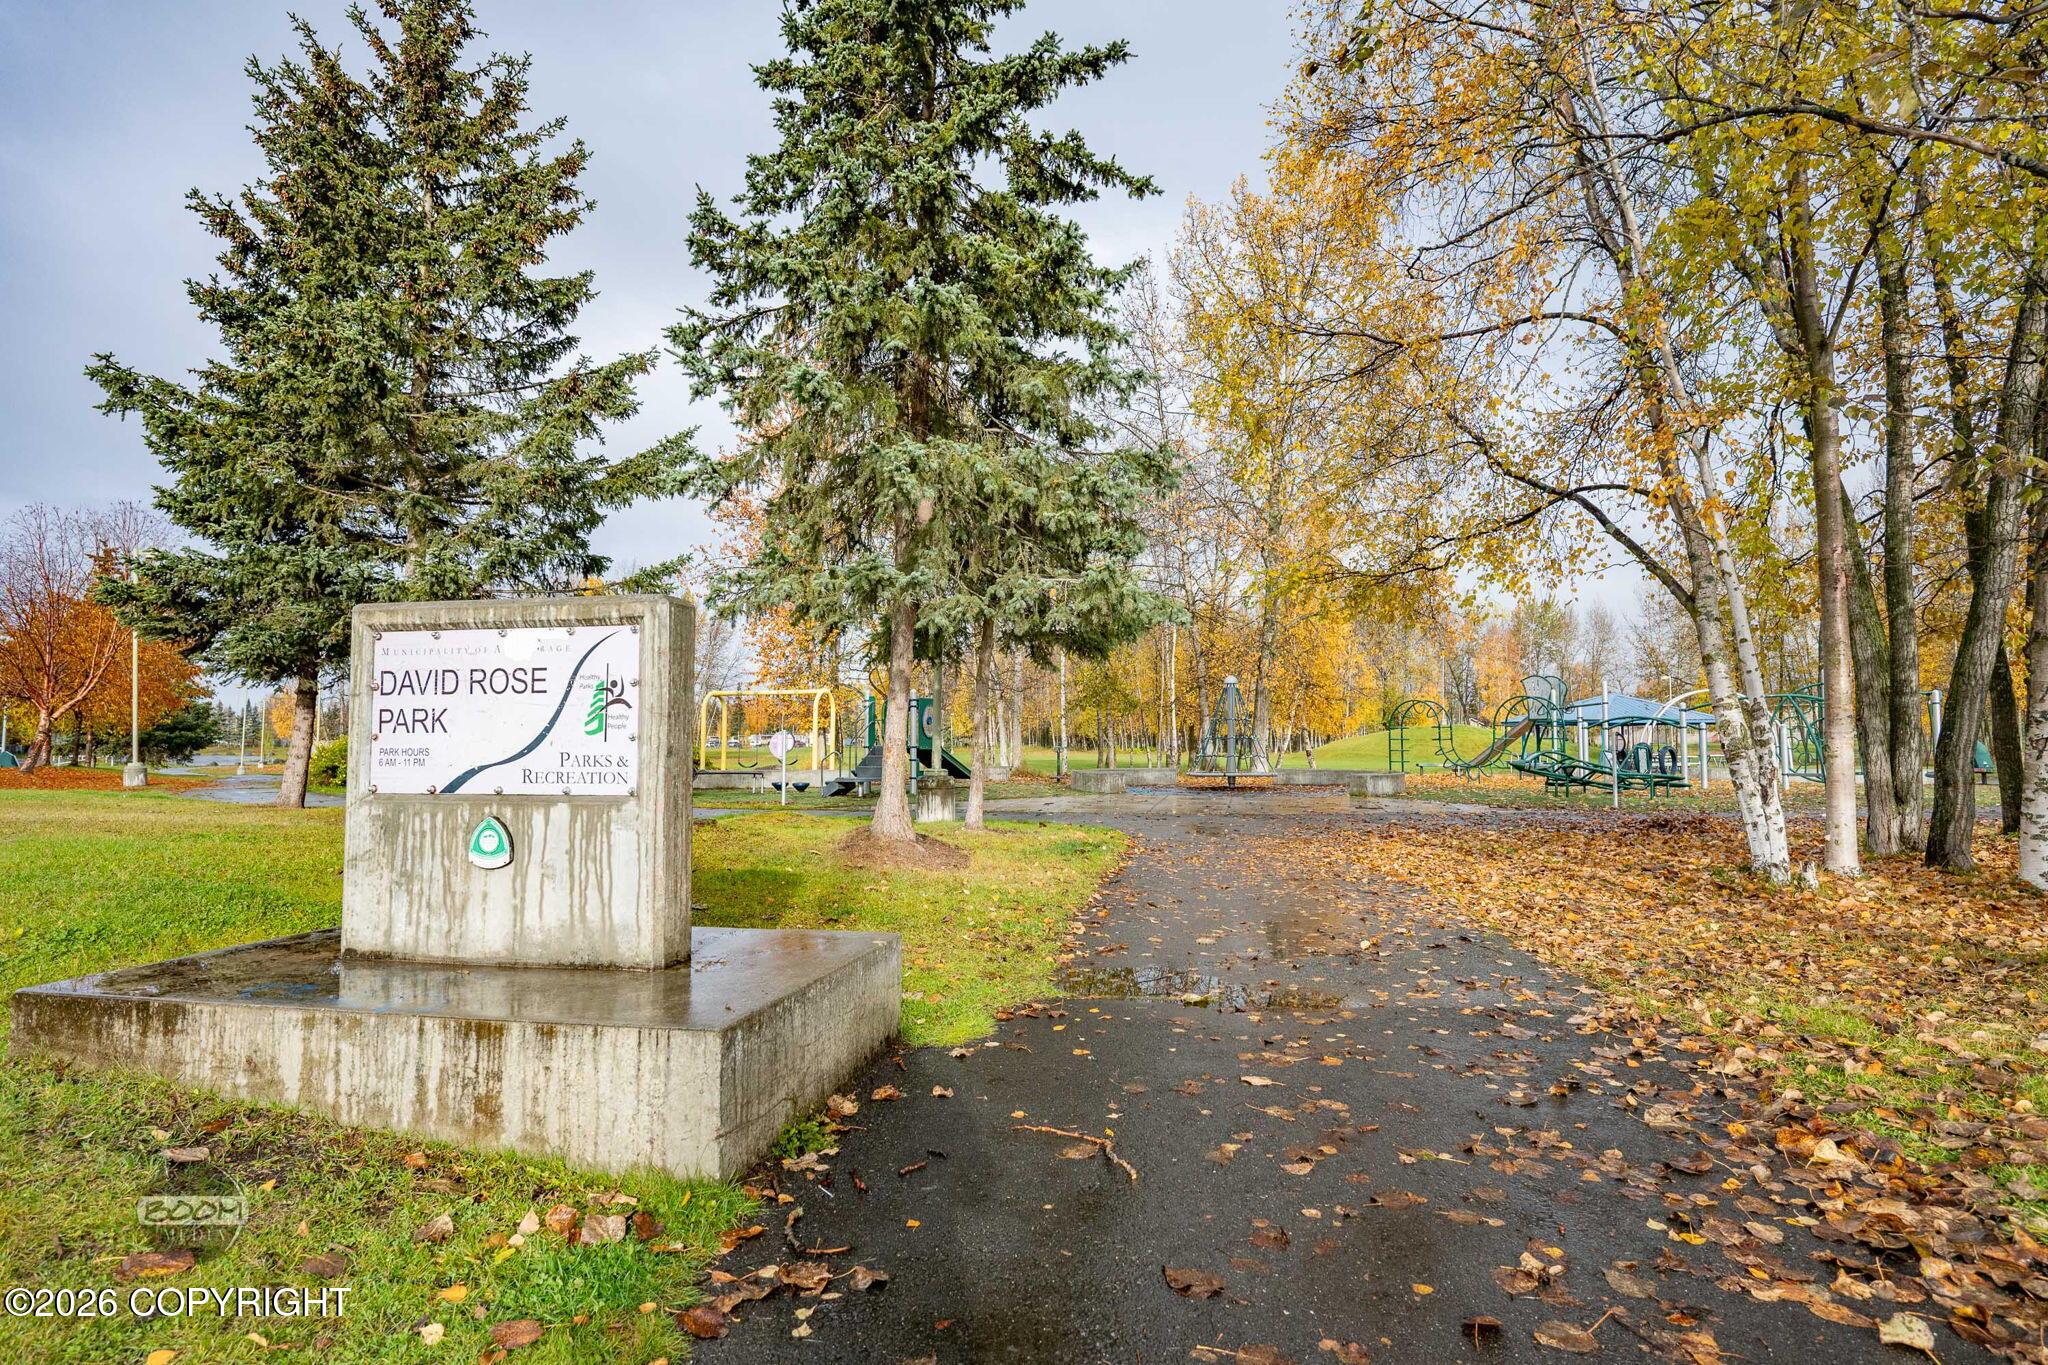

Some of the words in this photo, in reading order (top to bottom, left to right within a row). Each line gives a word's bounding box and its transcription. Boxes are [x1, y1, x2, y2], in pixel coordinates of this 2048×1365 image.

[494, 644, 572, 654] ARAGE
[380, 669, 459, 696] DAVID
[469, 667, 548, 695] ROSE
[379, 708, 448, 734] PARK
[608, 713, 630, 721] Healthy
[608, 722, 627, 730] People
[379, 747, 400, 756] PARK
[401, 747, 431, 757] HOURS
[378, 758, 384, 767] 6
[385, 758, 397, 767] AM
[403, 758, 411, 767] 11
[413, 758, 426, 767] PM
[560, 752, 612, 768] PARKS
[616, 755, 629, 768] &
[522, 768, 629, 785] RECREATION
